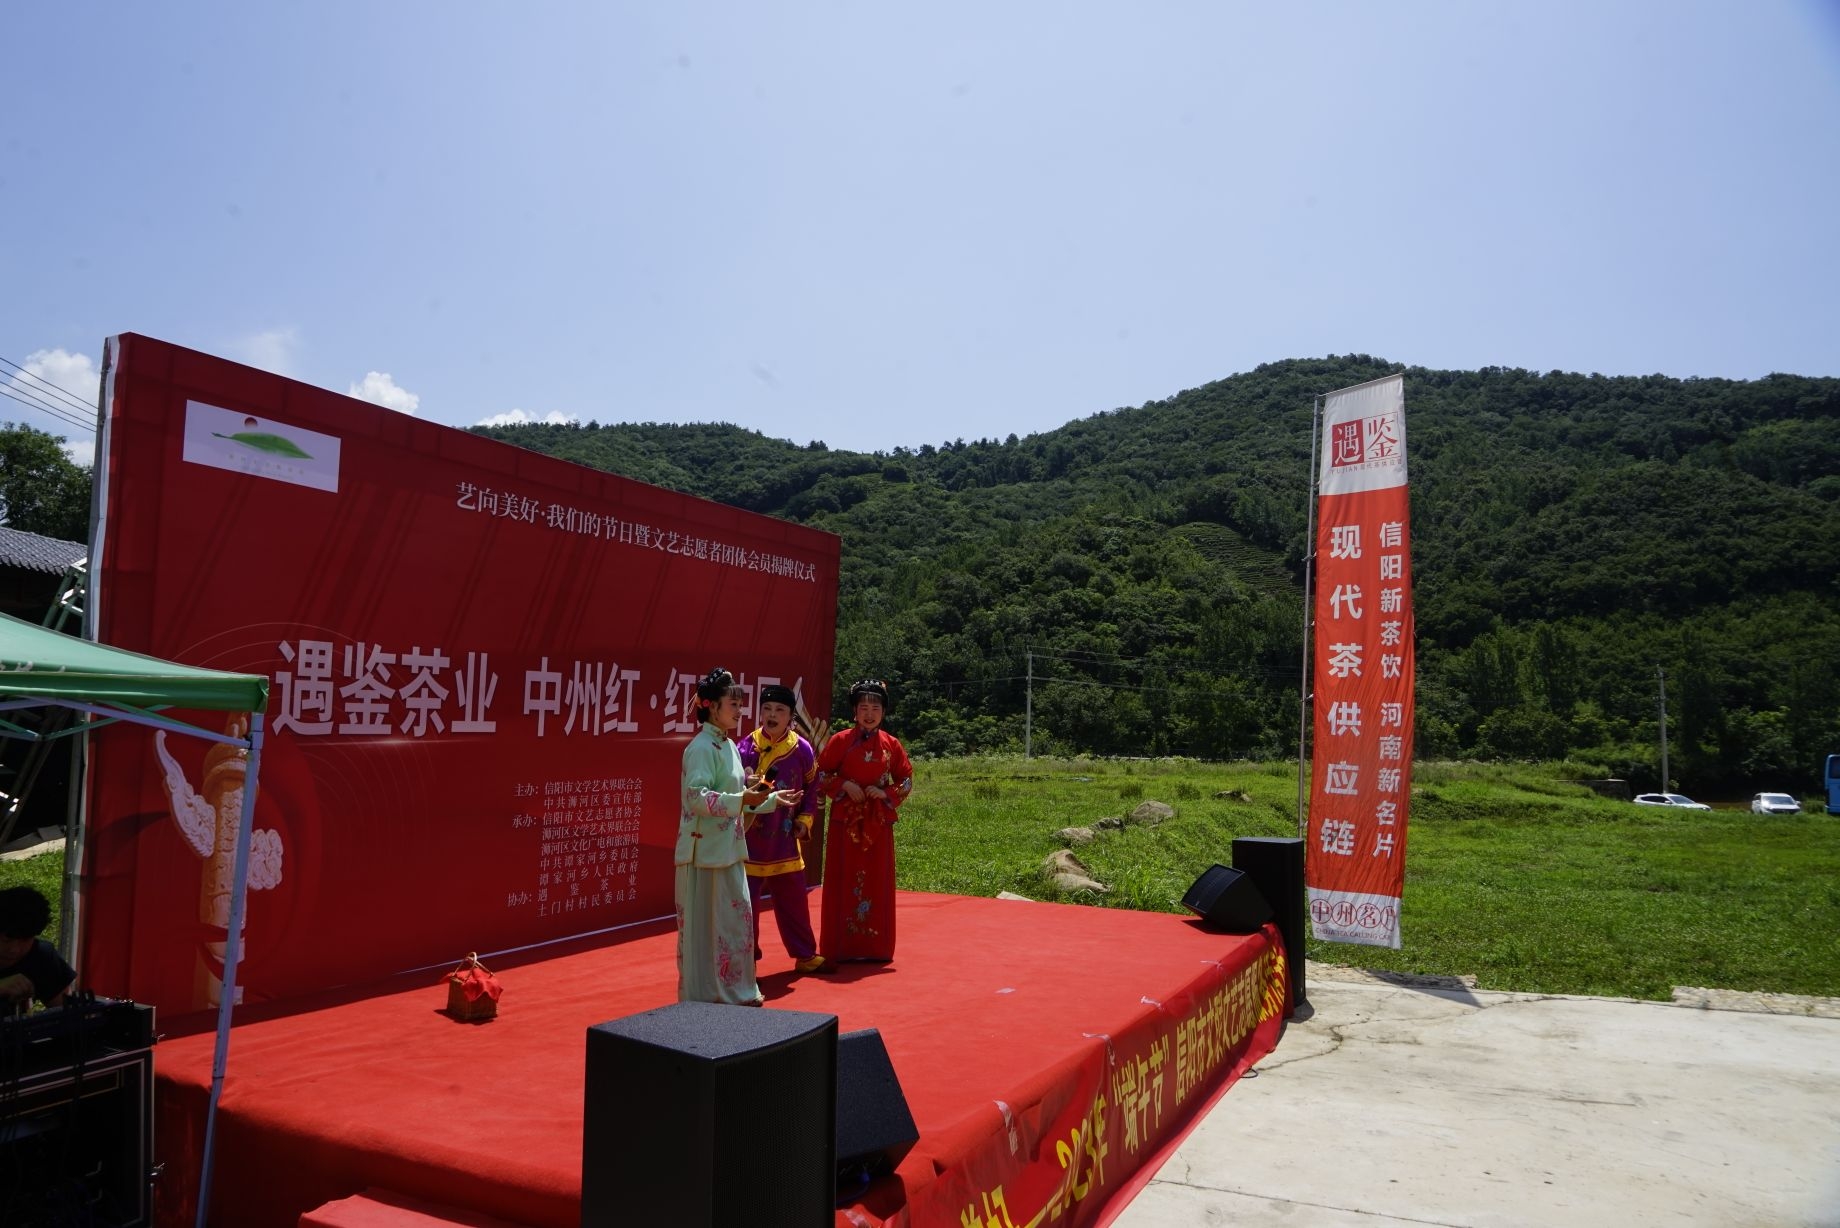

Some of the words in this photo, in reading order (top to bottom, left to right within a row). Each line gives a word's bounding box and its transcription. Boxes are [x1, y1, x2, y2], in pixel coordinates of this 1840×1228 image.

[1334, 417, 1398, 465] 遇鉴
[1379, 521, 1403, 679] 信阳新茶饮
[272, 639, 499, 737] 遇鉴茶业
[1320, 525, 1363, 856] 现代茶供应链
[542, 805, 642, 826] 信阳市文艺志愿者协会
[544, 778, 643, 796] 信阳市文学艺术界联合会
[1372, 702, 1403, 859] 河南新名片
